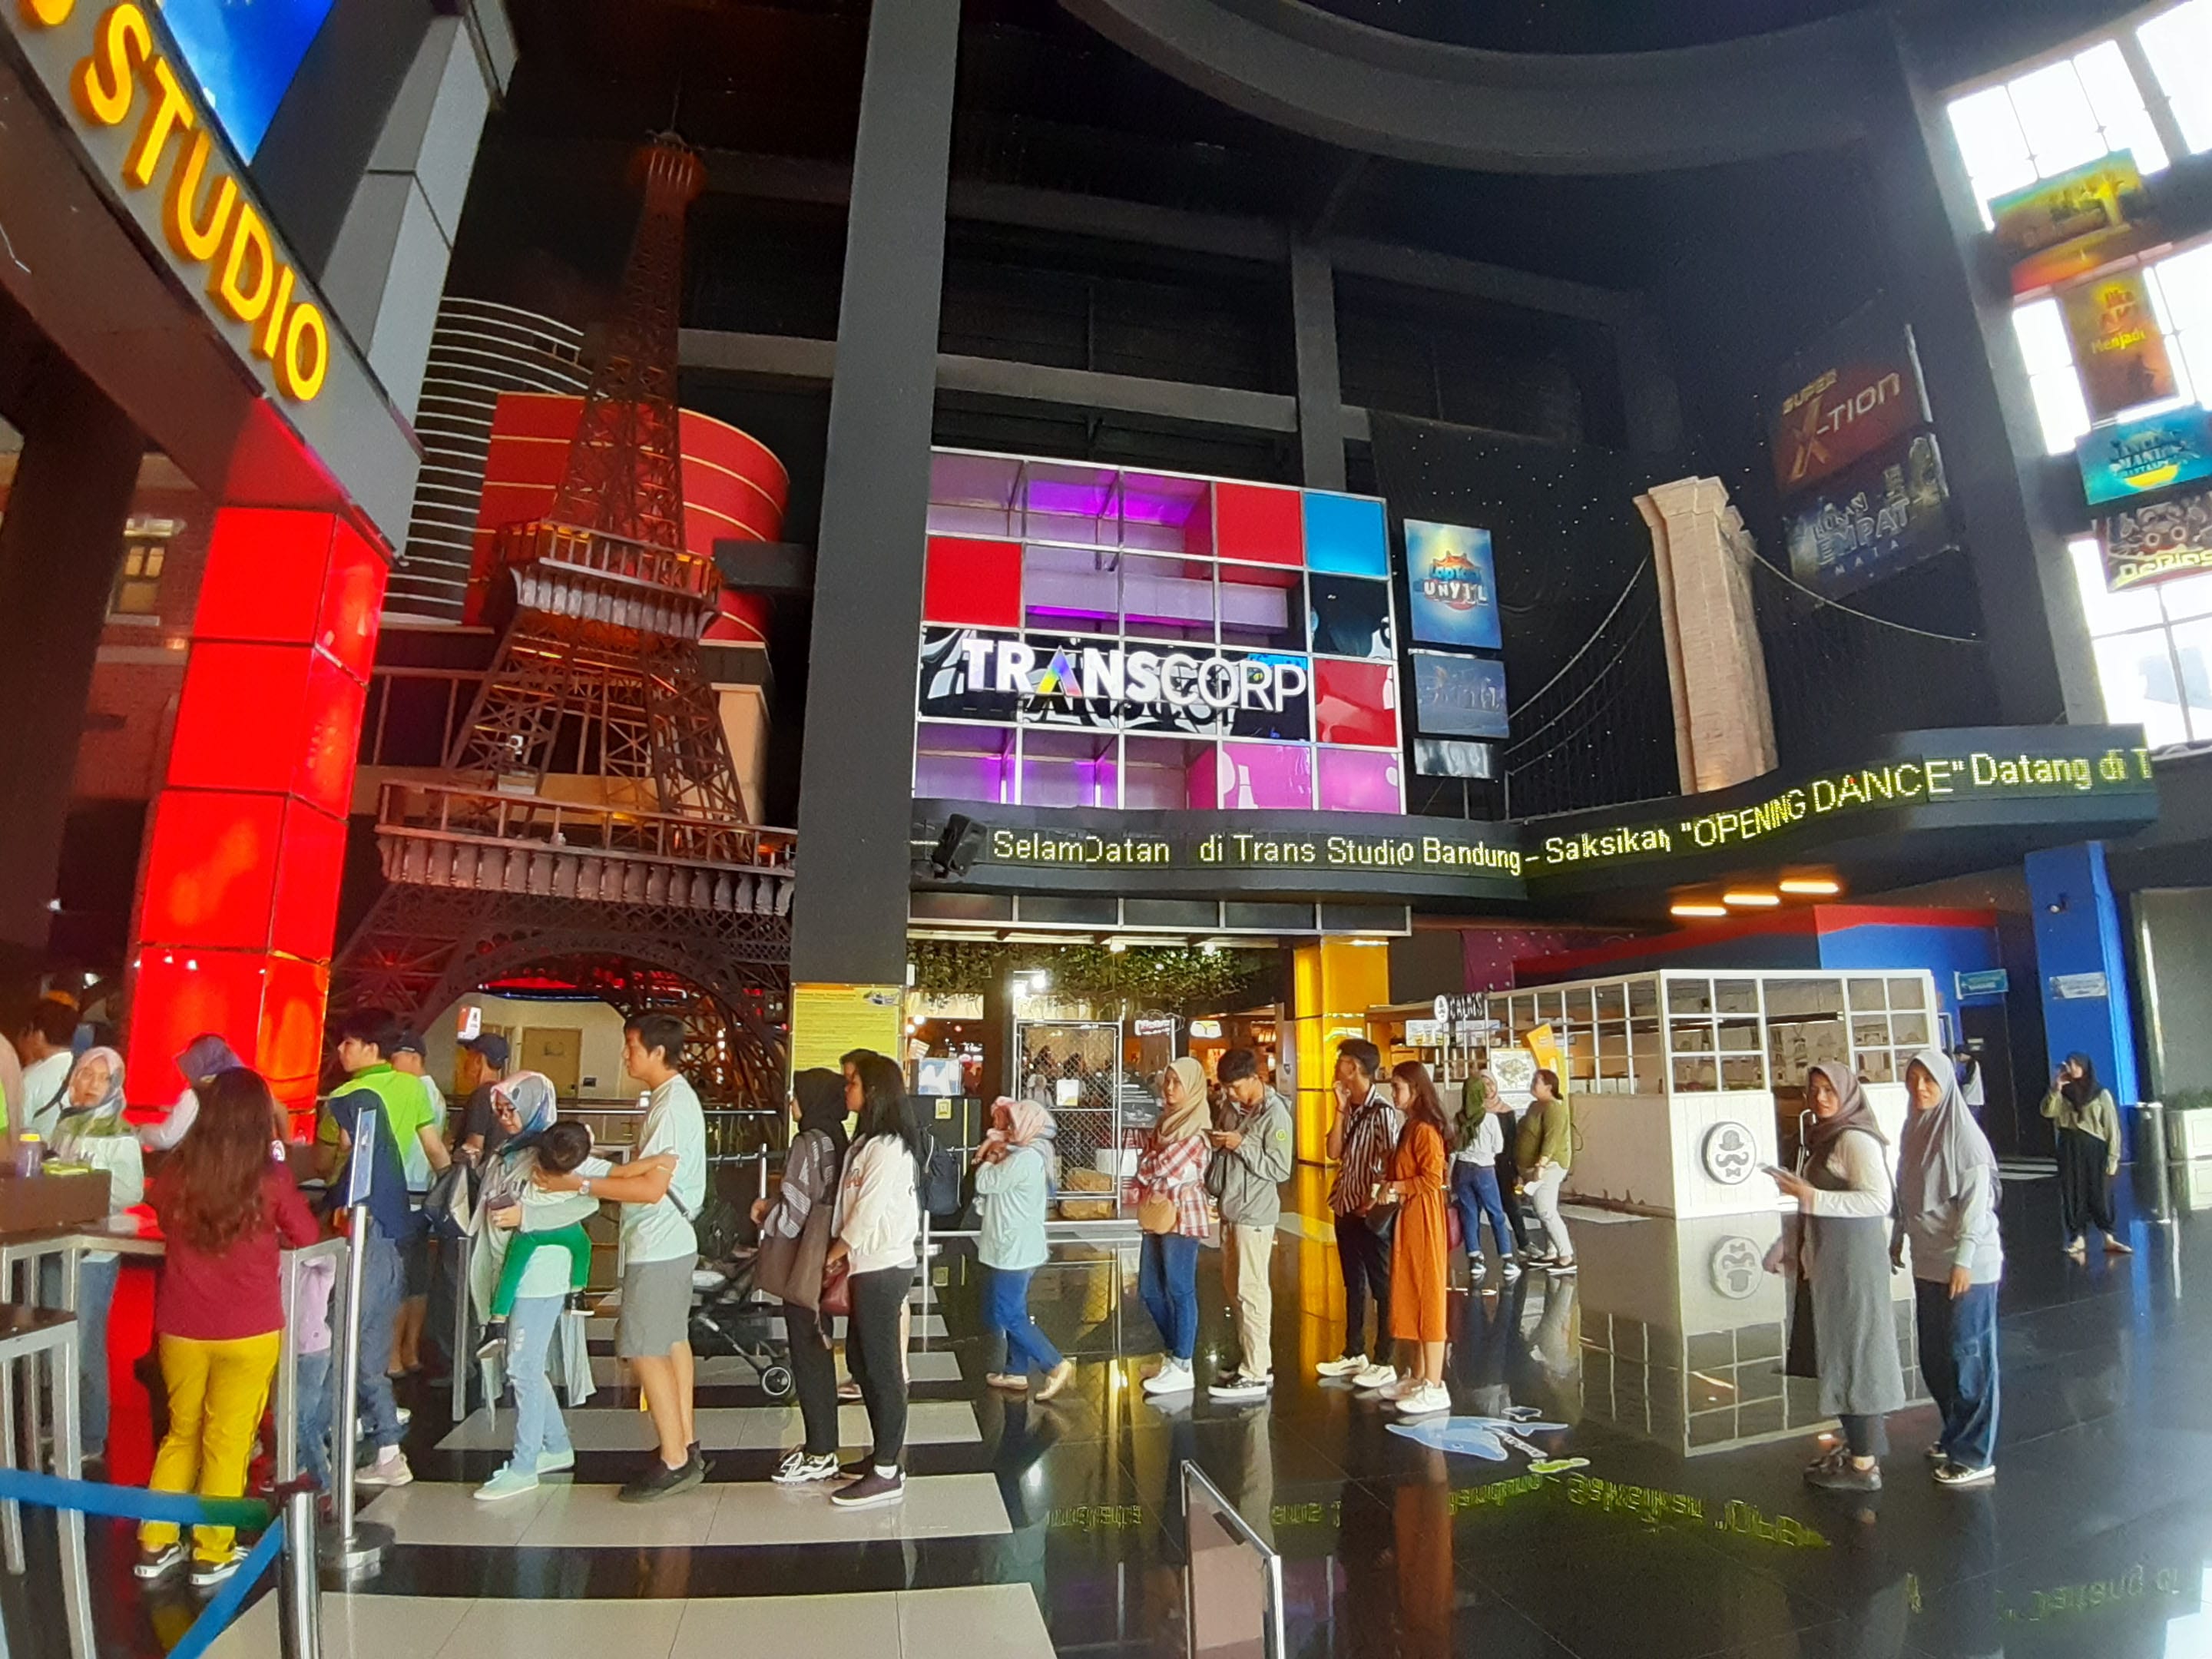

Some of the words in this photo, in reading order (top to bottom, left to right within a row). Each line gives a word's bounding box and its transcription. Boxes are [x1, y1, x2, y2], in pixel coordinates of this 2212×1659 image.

[71, 2, 328, 402] STUDIO
[1782, 368, 1838, 416] SUPER
[1816, 497, 1910, 566] EMPAT
[962, 638, 1306, 713] TRANSCORP
[1199, 834, 1223, 862] di
[1233, 834, 1316, 863] Trans
[1327, 836, 1414, 866] Studio
[1422, 836, 1521, 876] Bandung
[1545, 828, 1671, 864] Saksikan
[1811, 760, 1965, 813] DANCE"
[1970, 752, 2092, 790] Datang
[2099, 748, 2128, 781] di
